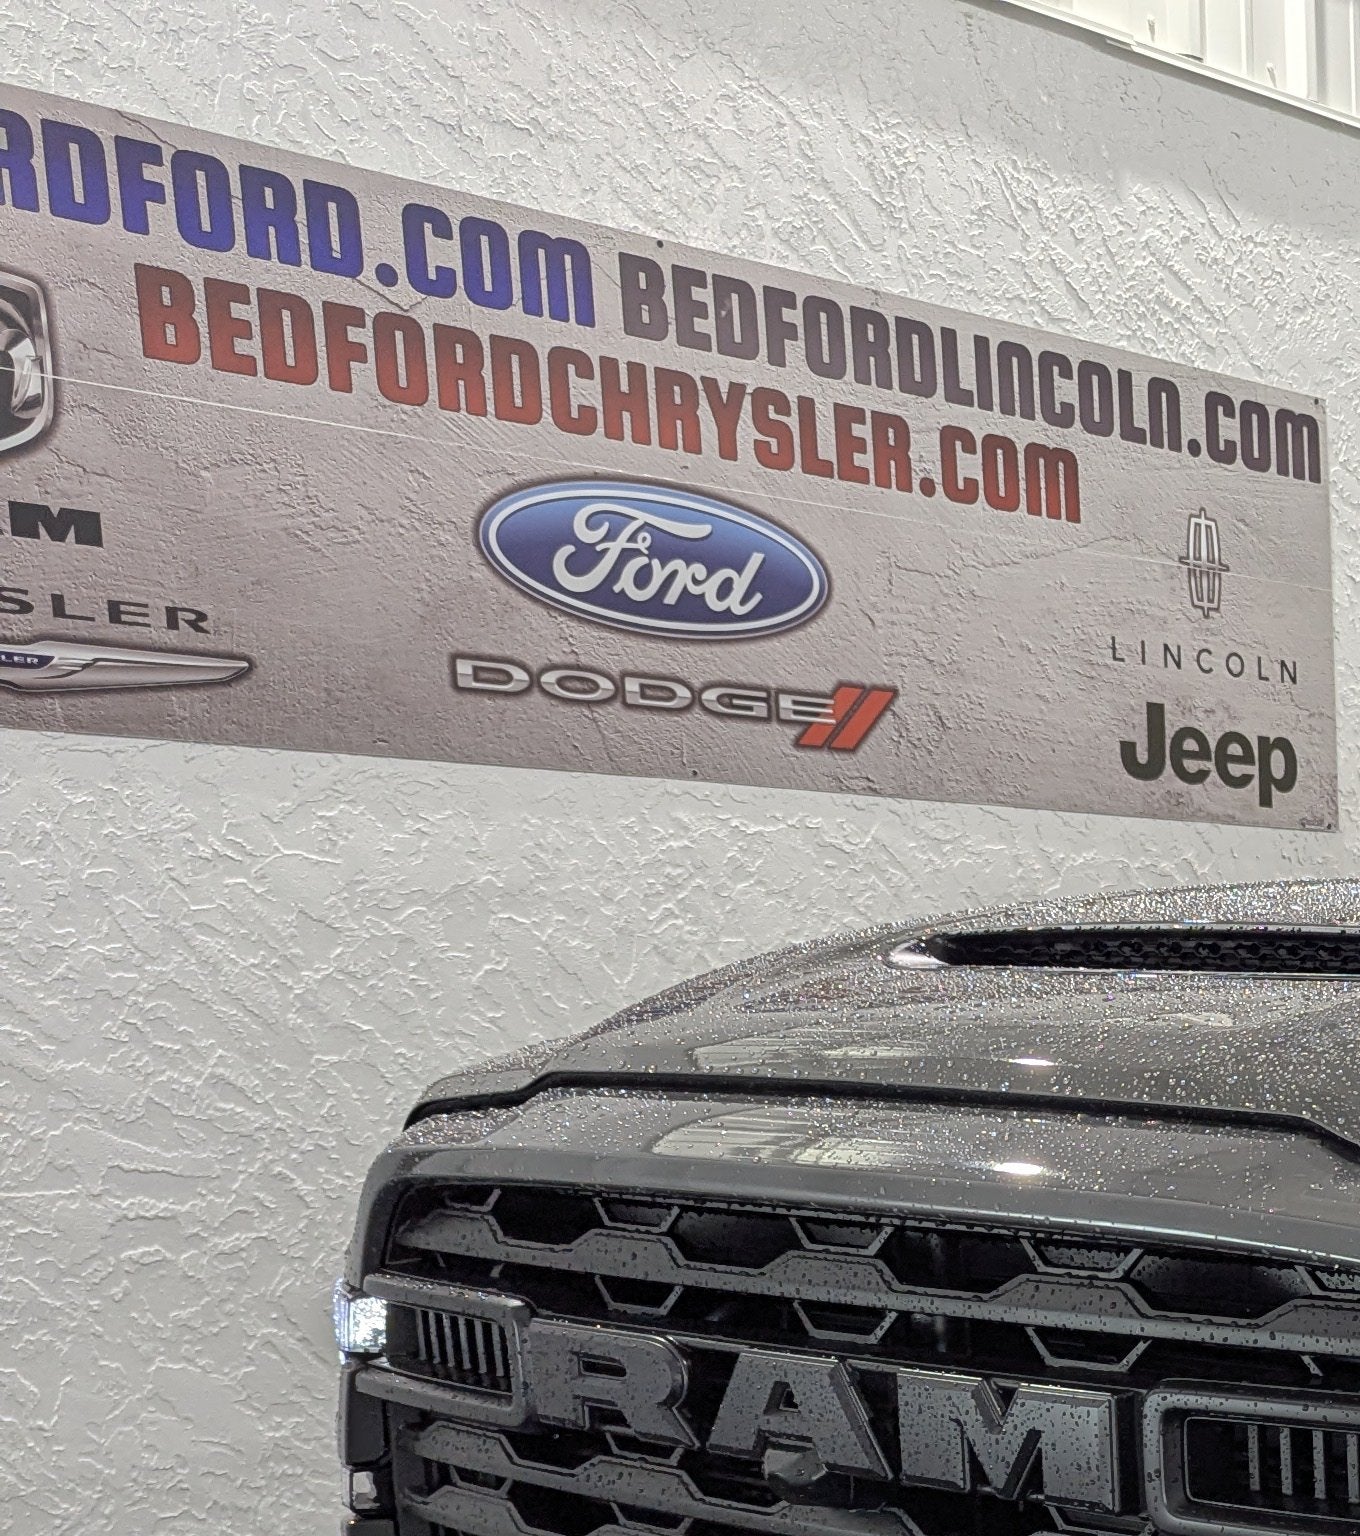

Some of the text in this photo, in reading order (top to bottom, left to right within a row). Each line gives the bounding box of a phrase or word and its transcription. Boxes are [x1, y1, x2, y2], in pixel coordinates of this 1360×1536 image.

[134, 262, 1081, 524] BEDFORDCHRYSLER.COM
[617, 252, 1321, 484] BEDFORDLINCOLN.COM
[552, 502, 763, 616] Ford
[455, 657, 837, 727] DODGE
[1110, 635, 1298, 685] LINCOLN
[1119, 701, 1298, 809] Jeep
[527, 1316, 1119, 1513] RAM
